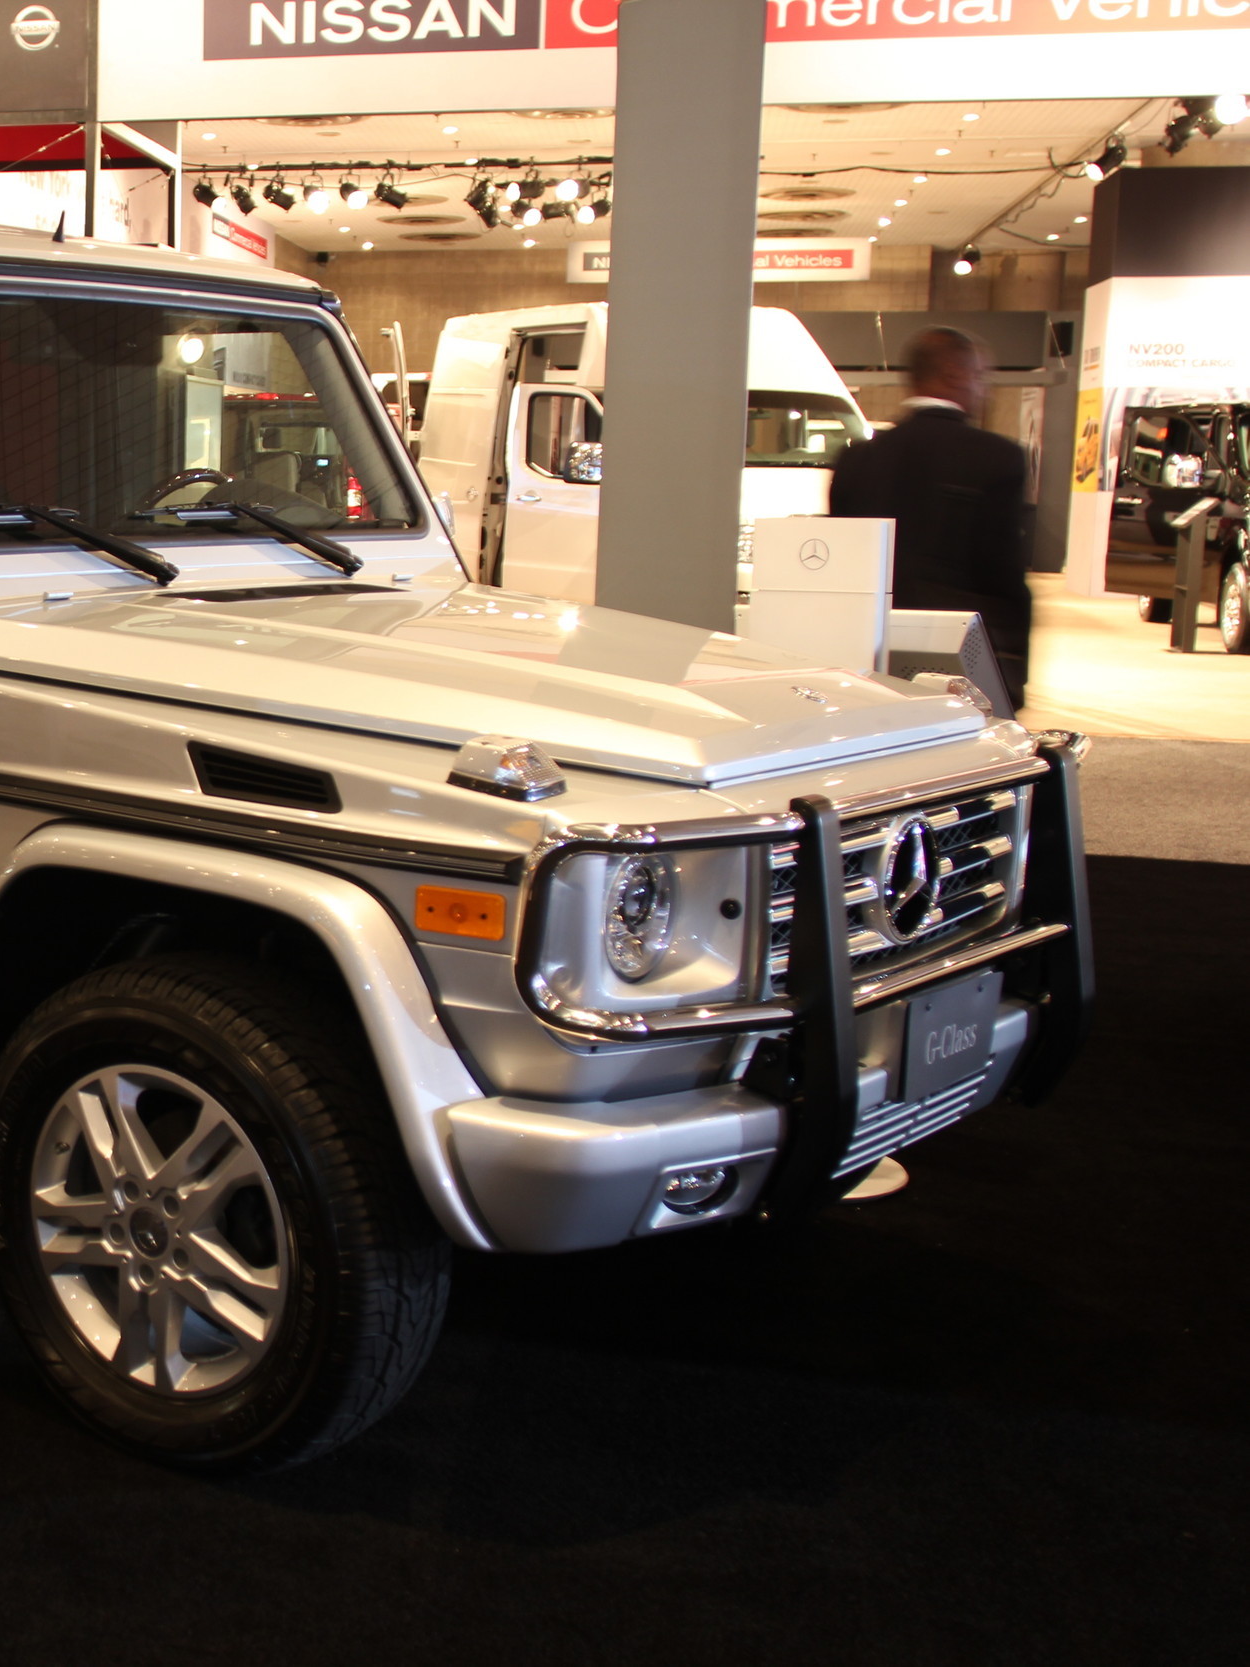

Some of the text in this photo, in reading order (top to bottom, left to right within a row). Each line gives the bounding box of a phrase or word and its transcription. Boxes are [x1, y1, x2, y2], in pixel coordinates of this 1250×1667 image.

[250, 0, 516, 45] NISSAN
[774, 254, 843, 267] Vehicles
[1129, 343, 1185, 355] NV200
[926, 1023, 978, 1065] G-Class
